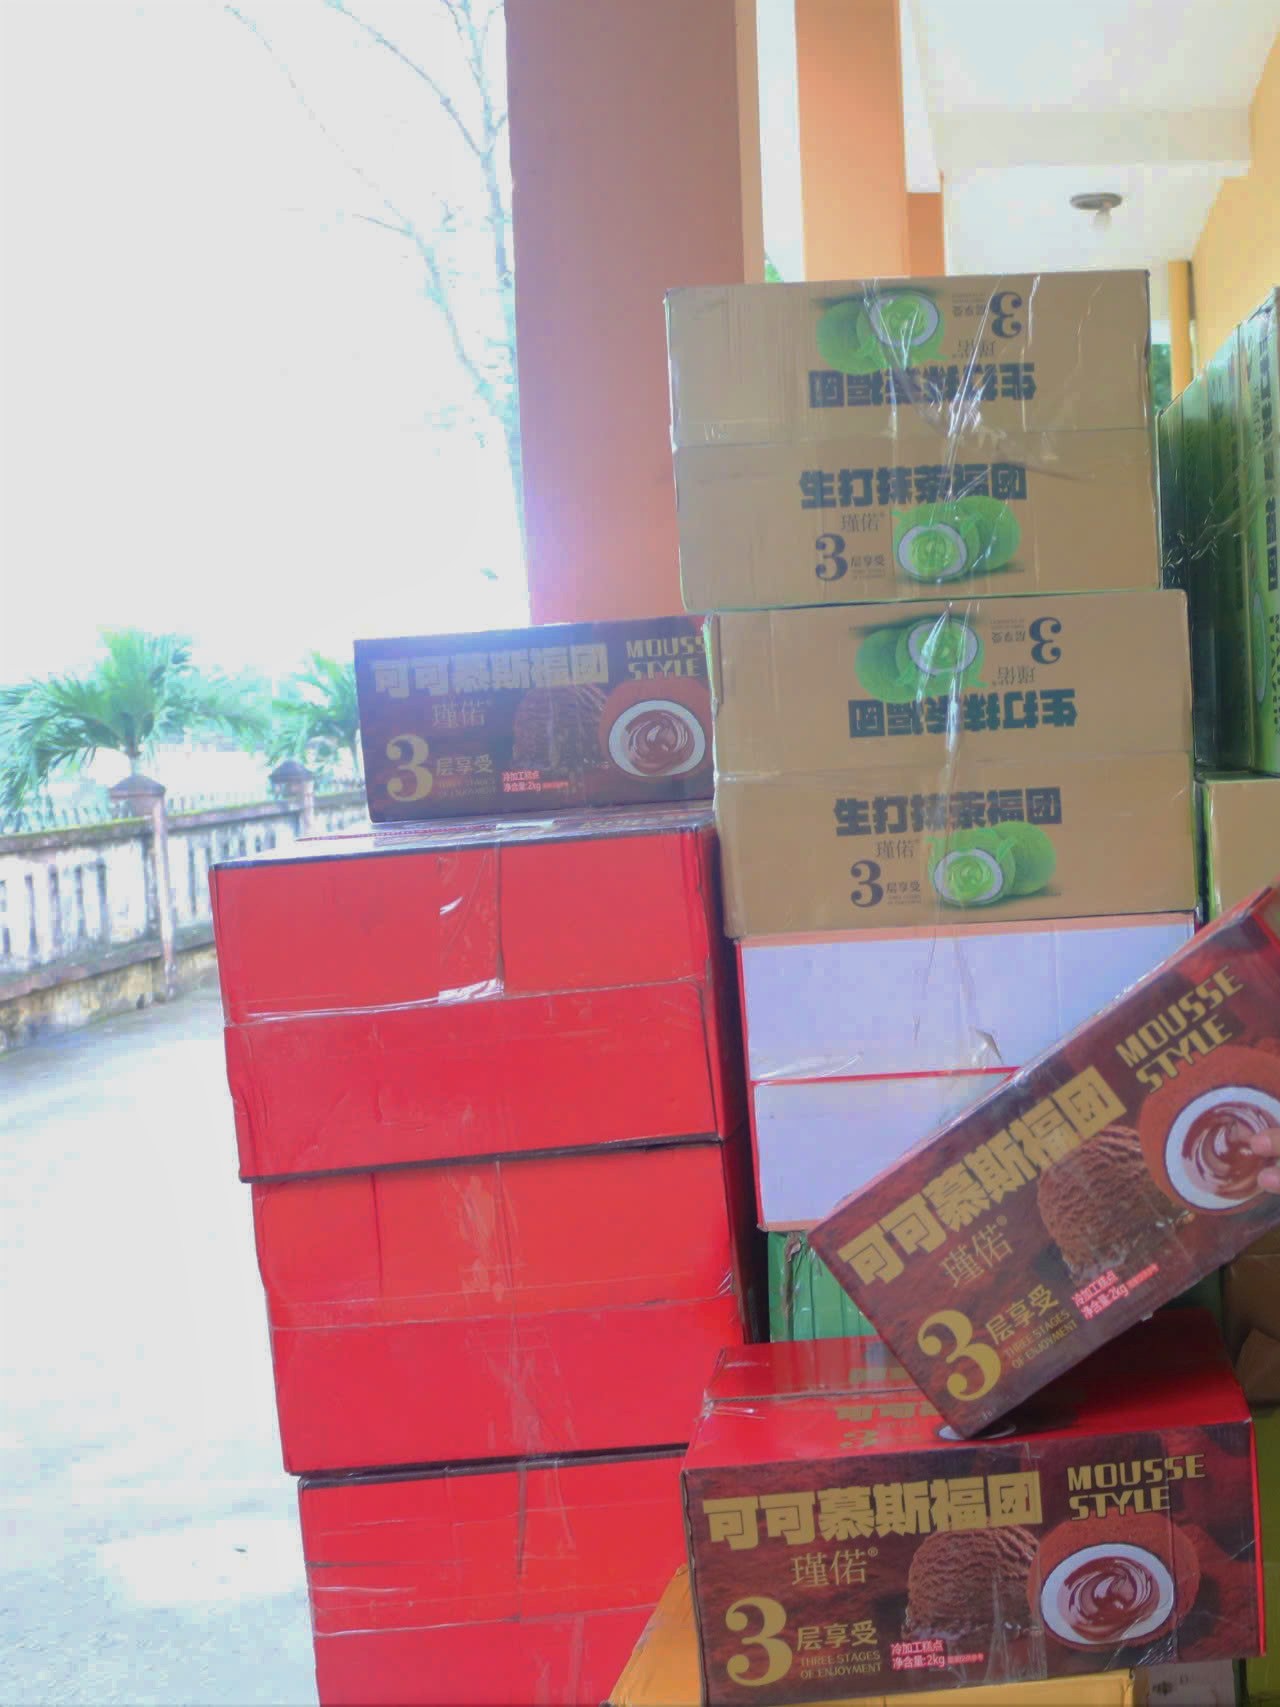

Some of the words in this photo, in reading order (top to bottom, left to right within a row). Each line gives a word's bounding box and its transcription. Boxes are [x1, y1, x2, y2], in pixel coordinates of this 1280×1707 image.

[991, 292, 1022, 338] 3
[815, 534, 848, 581] 3
[626, 636, 704, 657] MOUSS
[1030, 617, 1062, 665] 3
[628, 658, 699, 680] STYLE
[387, 734, 433, 802] 3
[436, 754, 493, 776] 层享受
[833, 787, 1062, 837] 生打抹茶福团
[850, 860, 884, 908] 3
[1116, 965, 1244, 1068] MOUSSE
[1135, 1014, 1233, 1094] STYLE
[837, 1065, 1127, 1286] 可可慕斯福团
[917, 1309, 1001, 1401] 3
[985, 1284, 1059, 1344] 层享受
[1067, 1454, 1205, 1491] MOUSSE
[703, 1472, 1043, 1550] 可可慕斯福团
[1070, 1486, 1171, 1521] STYLE
[725, 1596, 793, 1686] 3
[796, 1620, 877, 1651] 层享受
[801, 1653, 835, 1667] THREE
[836, 1651, 880, 1664] STAGES
[801, 1668, 814, 1679] OF
[818, 1663, 881, 1678] ENJOYMENT
